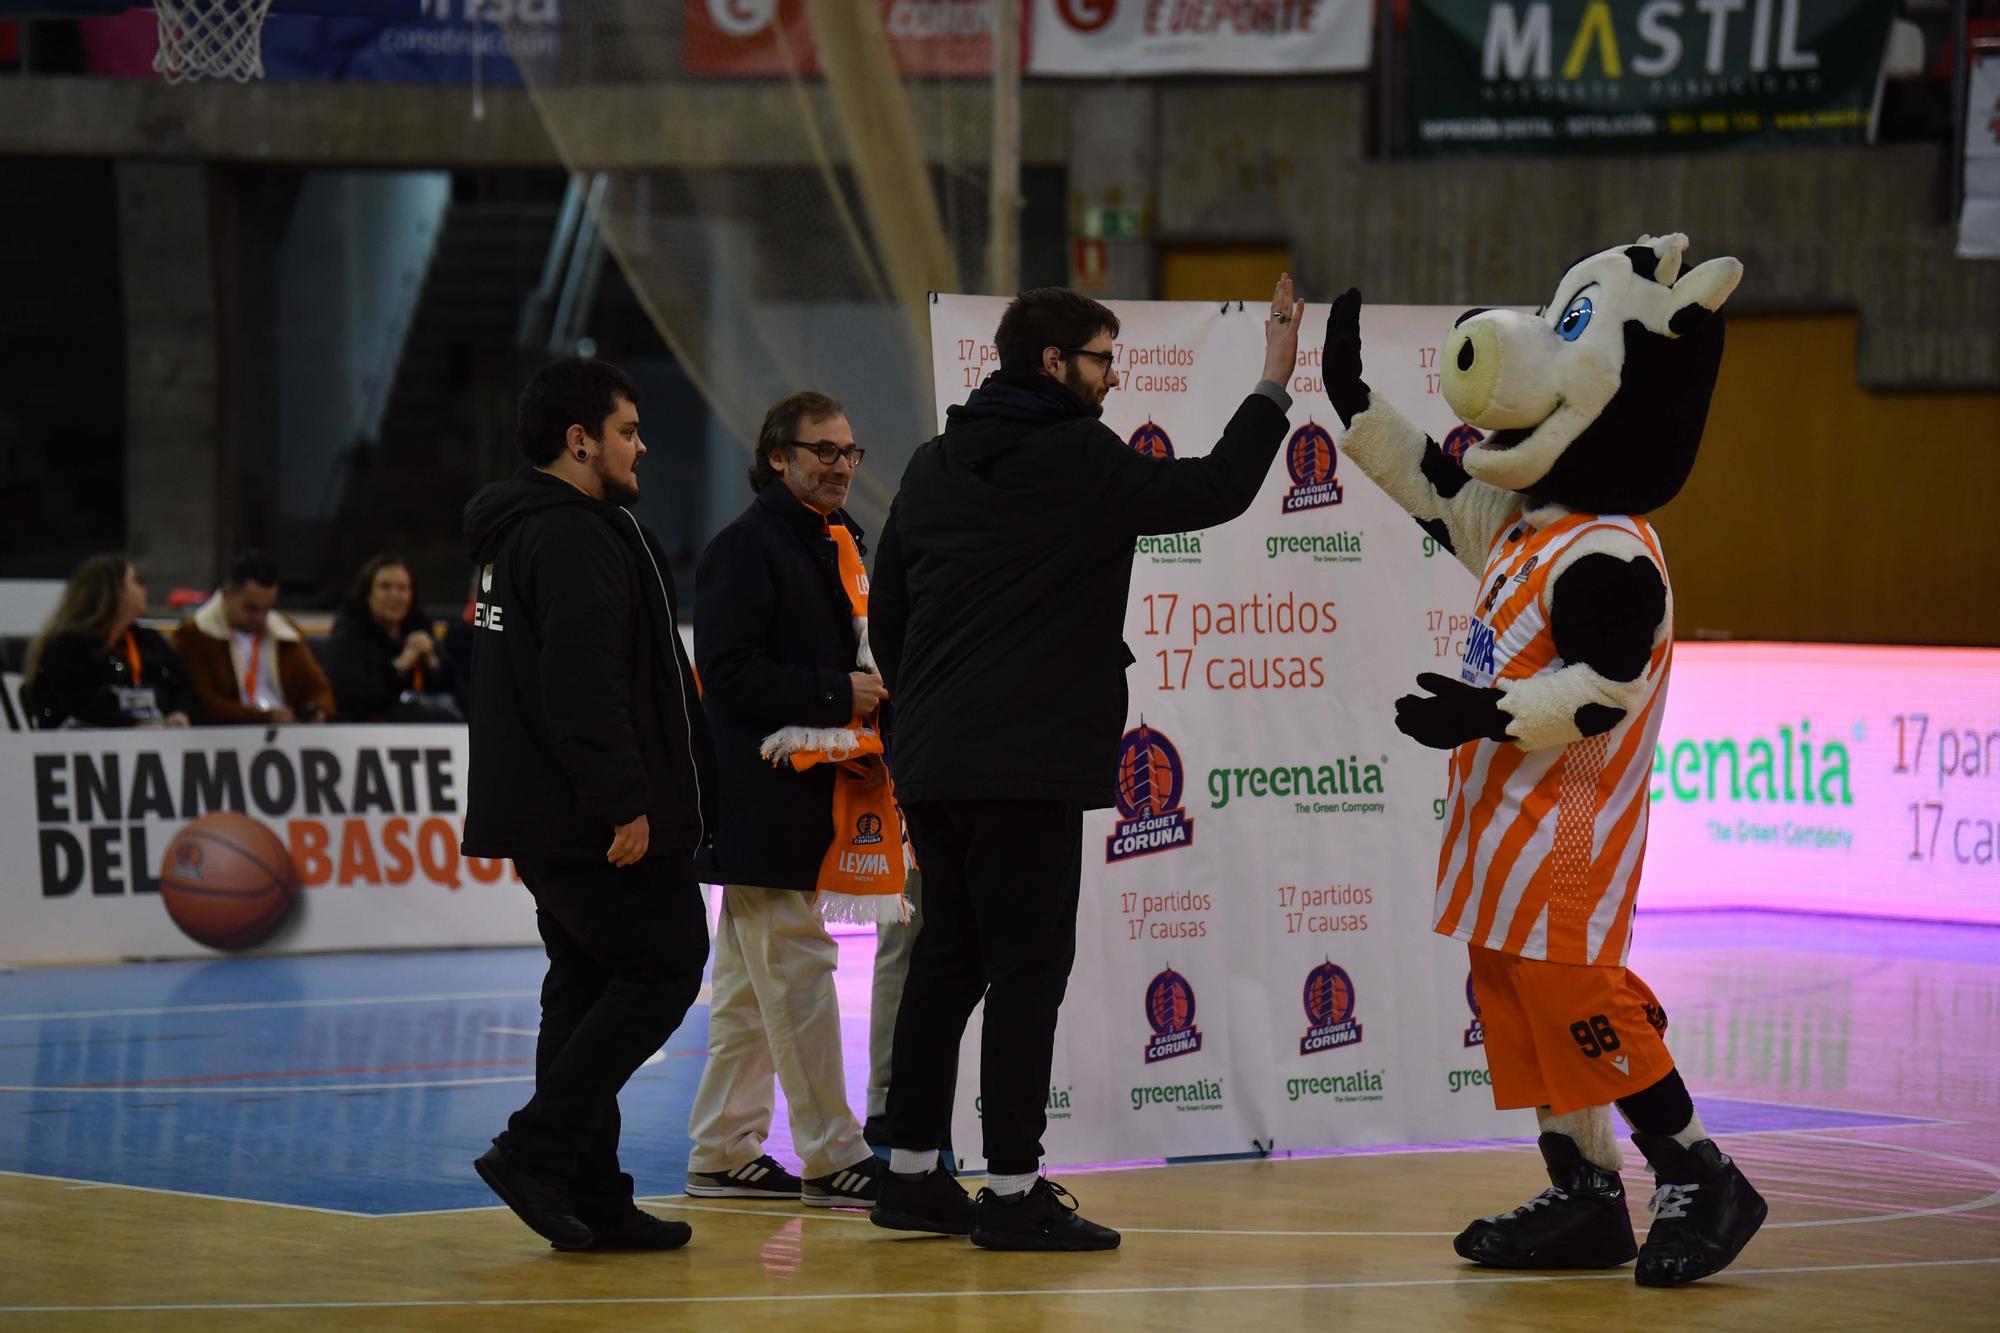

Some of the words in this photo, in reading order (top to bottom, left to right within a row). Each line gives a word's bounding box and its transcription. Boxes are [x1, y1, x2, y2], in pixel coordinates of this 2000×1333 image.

[957, 340, 975, 360] 17
[1129, 344, 1194, 368] partidos
[1419, 348, 1436, 368] 17
[963, 367, 981, 388] 17
[1136, 374, 1188, 392] causas
[1295, 376, 1326, 392] cau
[1293, 483, 1333, 497] BASQUET
[1266, 531, 1361, 558] greenalia
[1143, 594, 1178, 635] 17
[1193, 591, 1337, 645] partidos
[1427, 611, 1443, 631] 17
[1434, 636, 1450, 656] 17
[1156, 649, 1192, 690] 17
[1206, 656, 1324, 689] causas
[1891, 712, 1929, 775] 17
[1939, 729, 2000, 788] par
[34, 731, 457, 822] ENAMÓRATE
[1208, 755, 1385, 810] greenalia
[1295, 803, 1311, 814] The
[1313, 802, 1339, 814] Green
[1341, 801, 1385, 815] Company
[1121, 814, 1177, 836] BASQUET
[1908, 802, 1944, 862] 17
[1953, 818, 2000, 865] ca
[39, 824, 161, 897] DEL
[839, 850, 891, 876] LEYMA
[1120, 892, 1138, 913] 17
[1143, 890, 1211, 917] partidos
[1278, 886, 1297, 907] 17
[1301, 884, 1373, 911] partidos
[1128, 919, 1144, 940] 17
[1150, 920, 1207, 939] causas
[1285, 913, 1304, 934] 17
[1308, 913, 1368, 933] causas
[1154, 1030, 1192, 1046] BASQUET
[1311, 1021, 1351, 1037] BASQUET
[1570, 1014, 1620, 1058] 96
[1131, 1078, 1222, 1110] greenalia
[1287, 1069, 1383, 1101] greenalia
